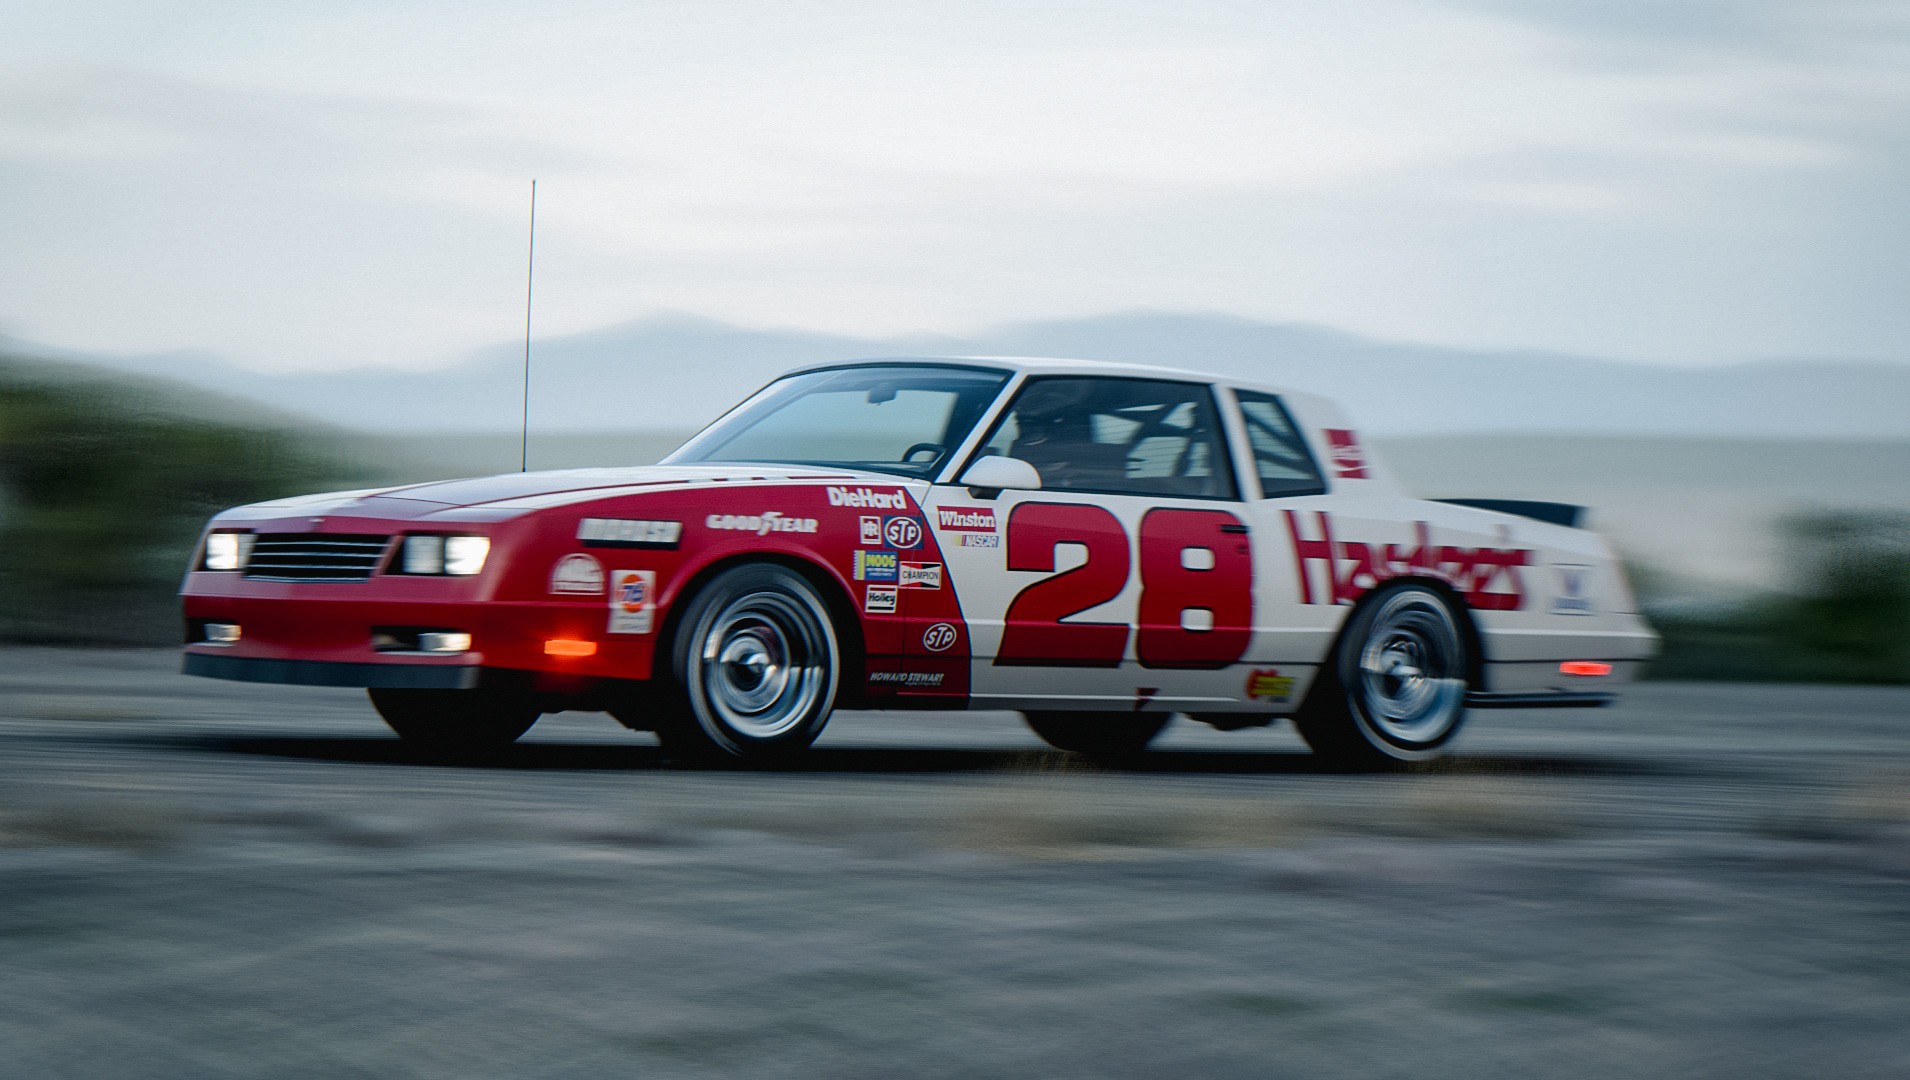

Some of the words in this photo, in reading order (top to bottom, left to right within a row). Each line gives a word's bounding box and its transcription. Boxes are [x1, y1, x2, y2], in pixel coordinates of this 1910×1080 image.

[827, 487, 907, 509] DieHard
[706, 512, 818, 536] GOODYEAR
[939, 511, 996, 527] Winston
[889, 520, 917, 543] STP
[964, 535, 998, 547] NASCAR
[866, 555, 896, 567] MOOG
[902, 571, 939, 579] CHAMPION
[992, 501, 1254, 670] 28
[868, 592, 896, 605] Holley
[926, 627, 953, 647] STP
[870, 672, 908, 681] HOWARD
[908, 673, 944, 682] STEWART
